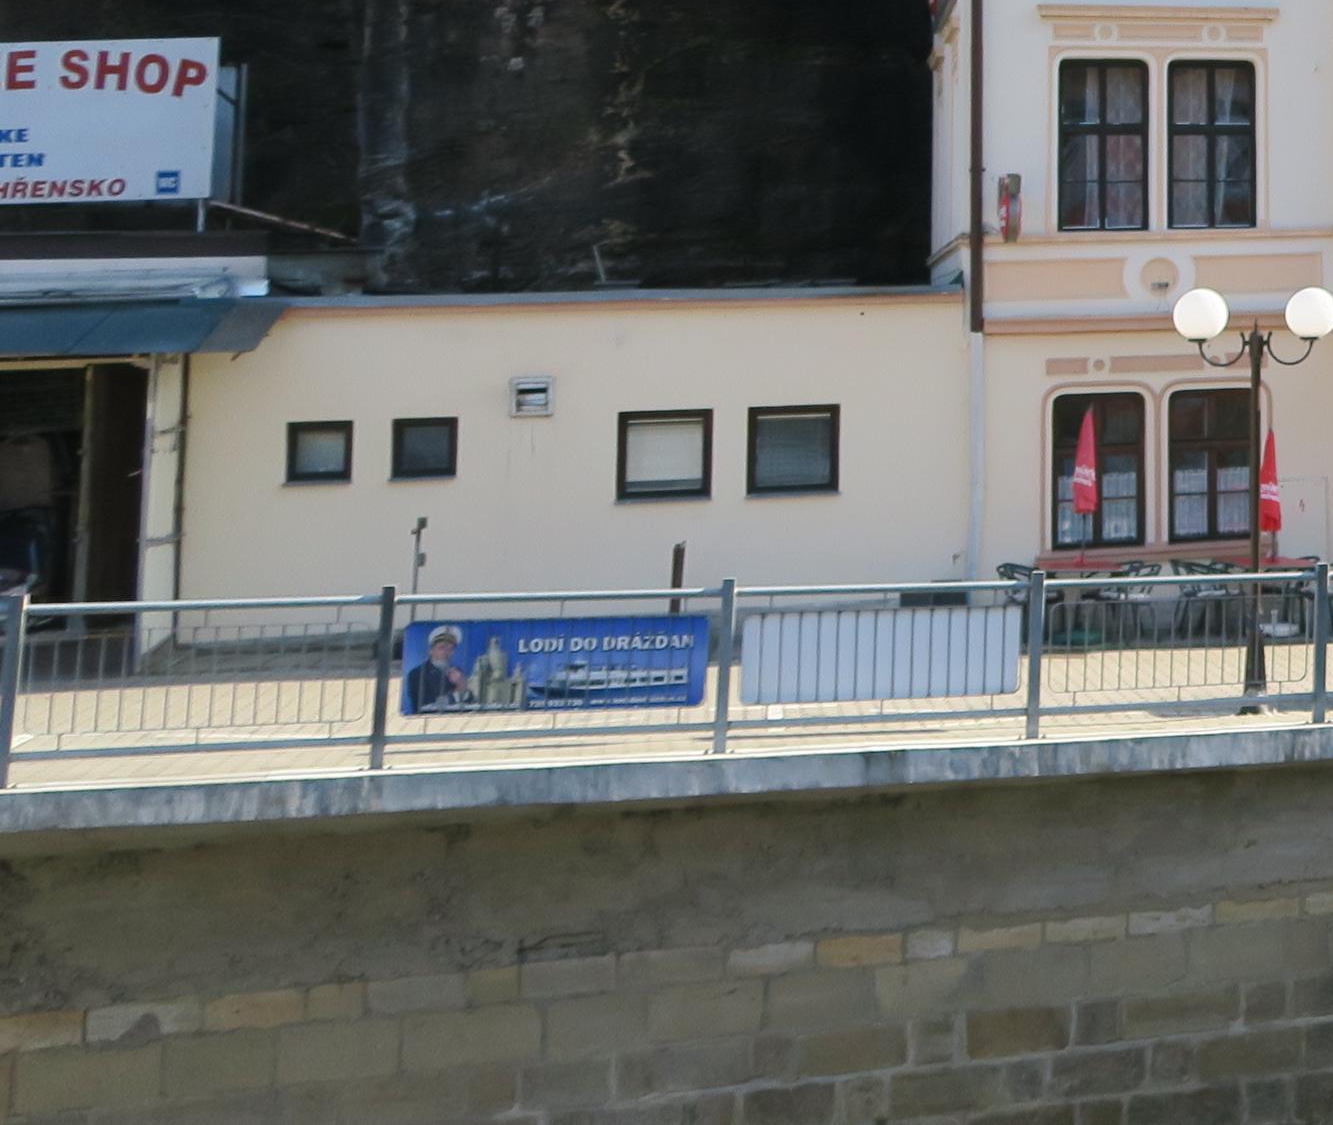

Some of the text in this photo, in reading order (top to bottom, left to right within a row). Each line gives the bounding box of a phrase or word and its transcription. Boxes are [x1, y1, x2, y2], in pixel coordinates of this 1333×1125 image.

[59, 49, 208, 97] SHOP
[518, 634, 564, 653] LODÍ
[569, 637, 597, 653] DO
